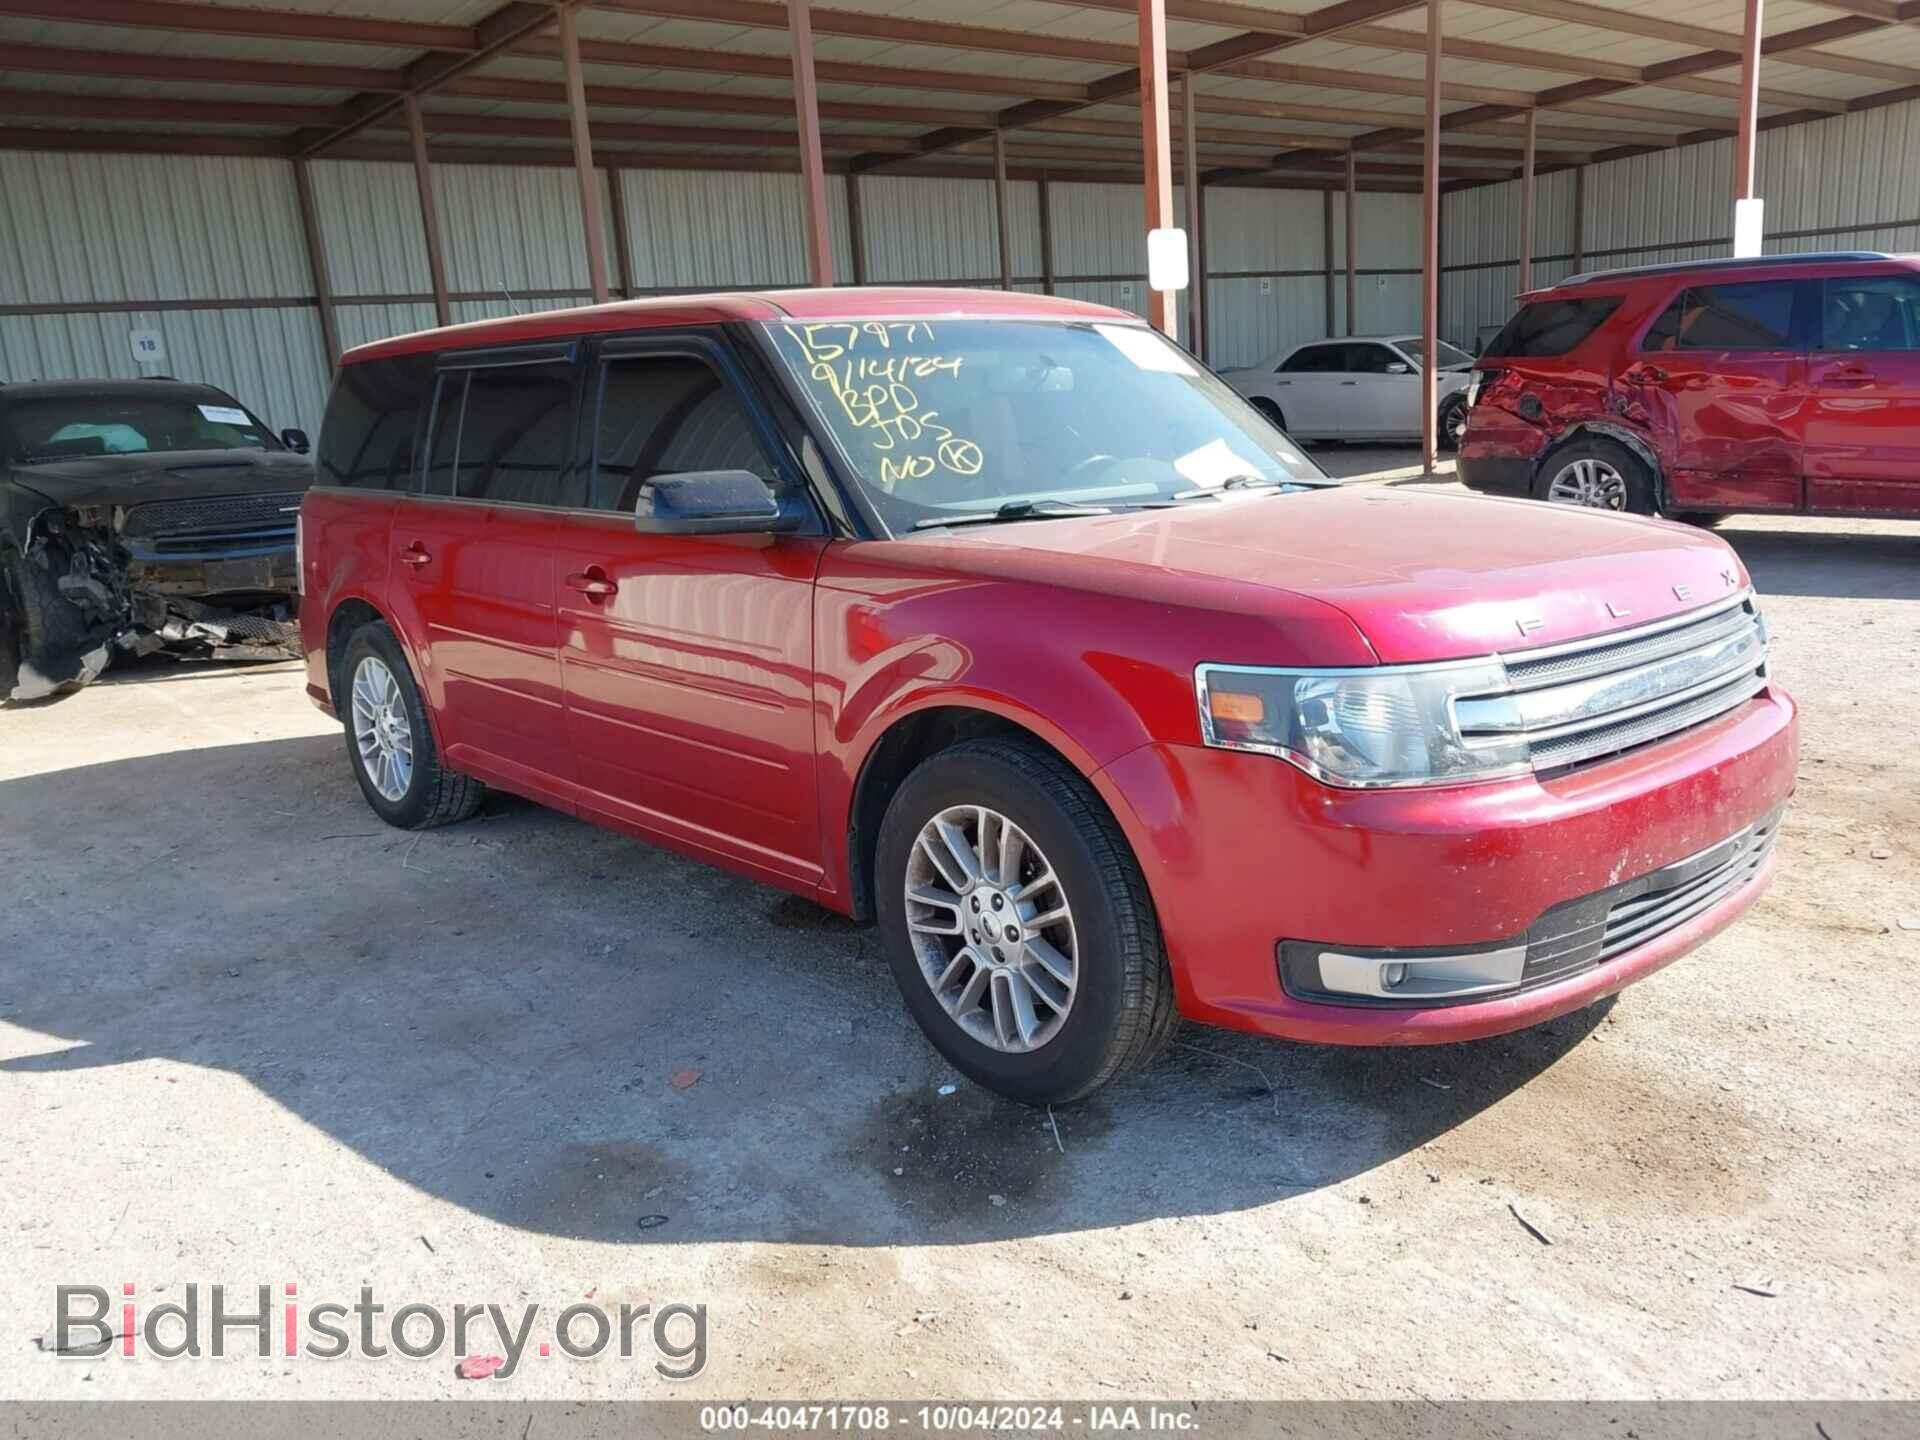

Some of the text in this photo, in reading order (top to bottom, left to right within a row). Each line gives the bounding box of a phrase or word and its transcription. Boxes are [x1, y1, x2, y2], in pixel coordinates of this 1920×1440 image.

[139, 340, 156, 351] 18
[784, 322, 936, 364] 157971
[881, 455, 935, 482] NO
[1514, 569, 1736, 637] FLEX
